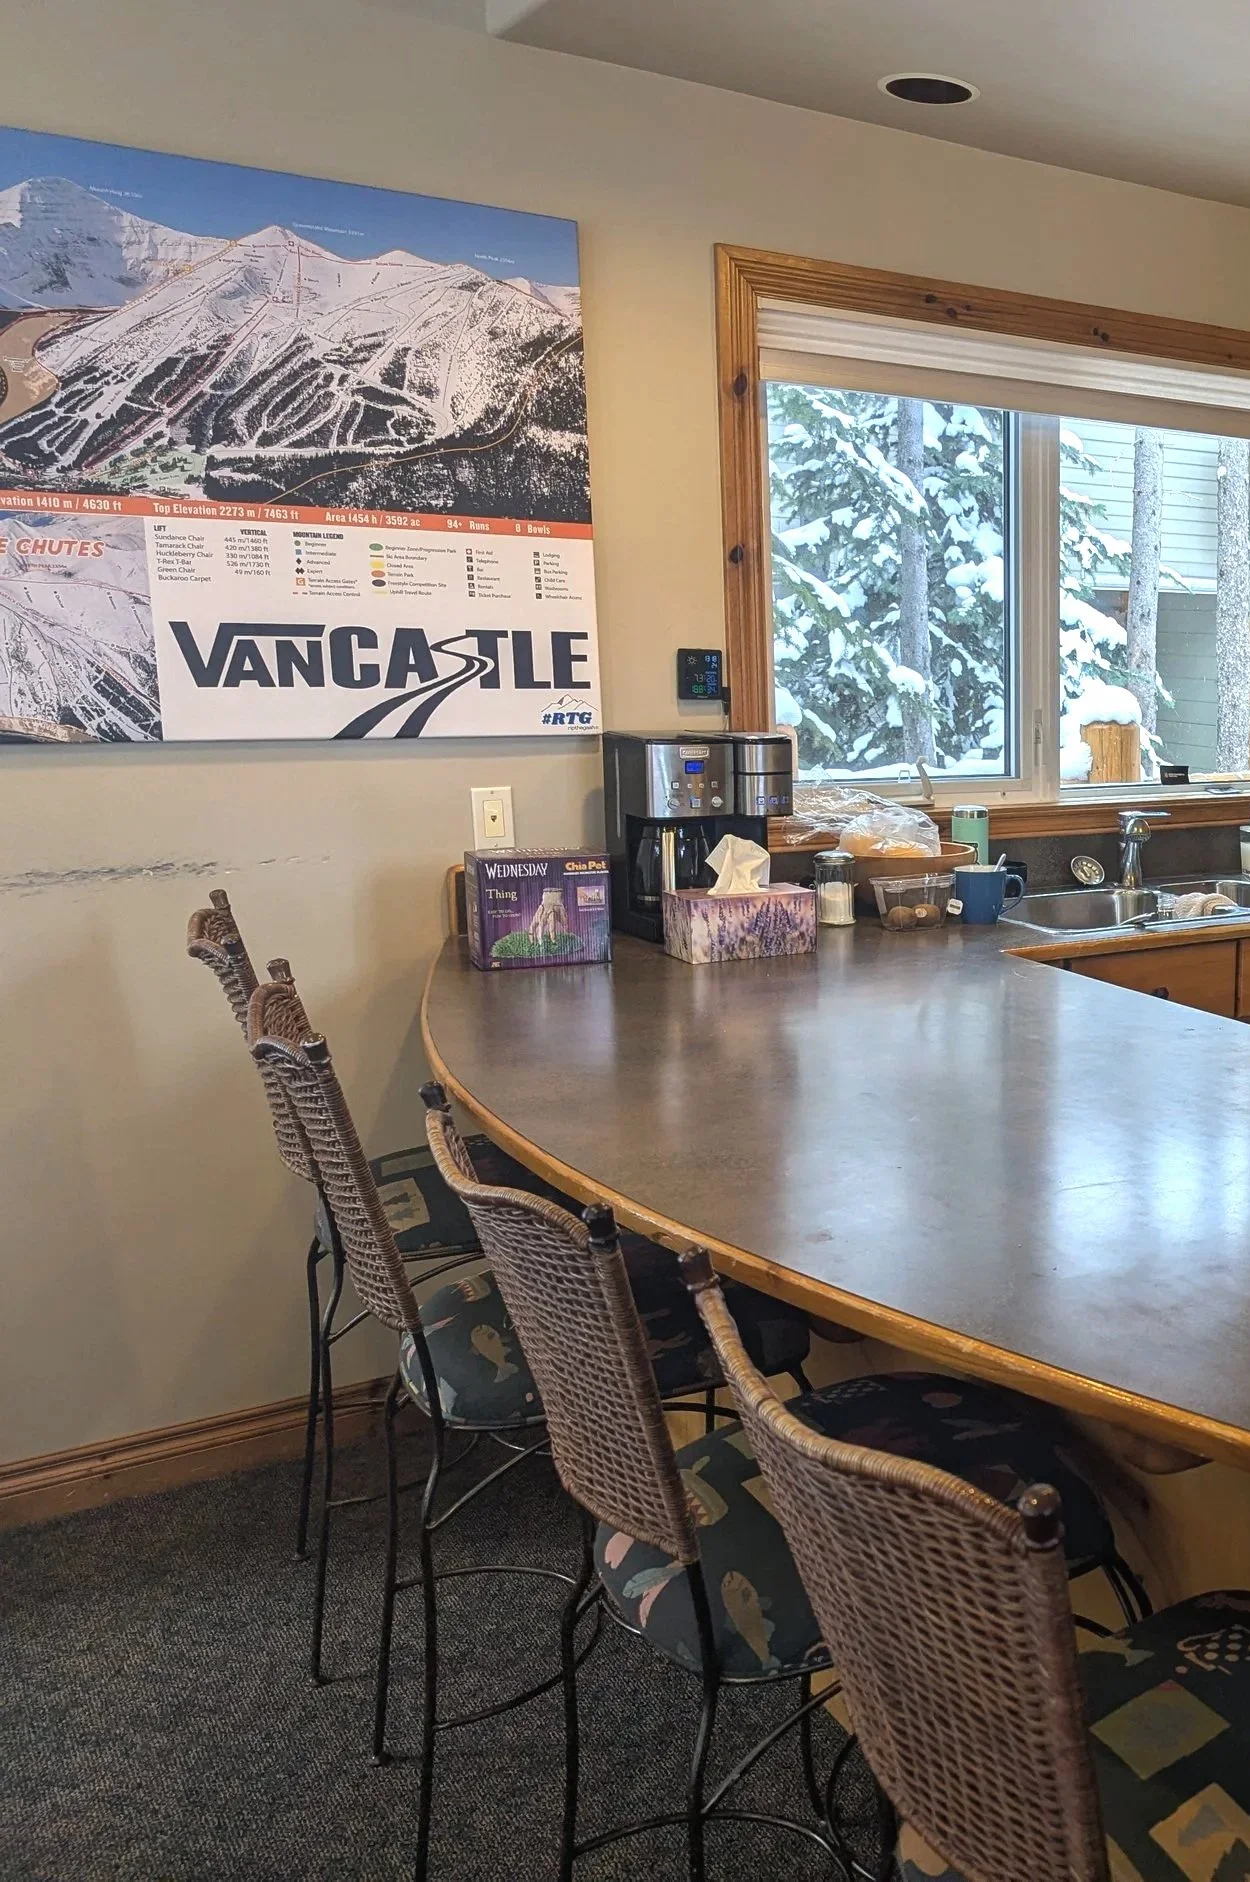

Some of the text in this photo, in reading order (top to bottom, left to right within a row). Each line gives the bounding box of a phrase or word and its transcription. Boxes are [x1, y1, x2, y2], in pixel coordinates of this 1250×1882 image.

[37, 496, 60, 508] 1410
[83, 499, 110, 511] 4630
[113, 500, 122, 511] ft
[153, 502, 171, 515] Top
[173, 503, 217, 516] Elevation
[219, 506, 244, 517] 2273
[247, 510, 255, 518] m
[264, 508, 288, 519] 7463
[290, 509, 299, 520] ft
[325, 512, 346, 522] Area
[348, 513, 370, 523] 1454
[371, 515, 378, 524] h
[385, 515, 408, 526] 3592
[446, 519, 490, 531] 94+ Runs
[515, 524, 551, 535] 8 Bowls
[16, 538, 105, 557] CHUTES
[156, 550, 195, 558] Huckleberry
[542, 712, 592, 725] #RTG
[485, 862, 548, 880] WEDNESDAY
[565, 860, 606, 871] Chia Pet
[486, 889, 518, 901] Thing
